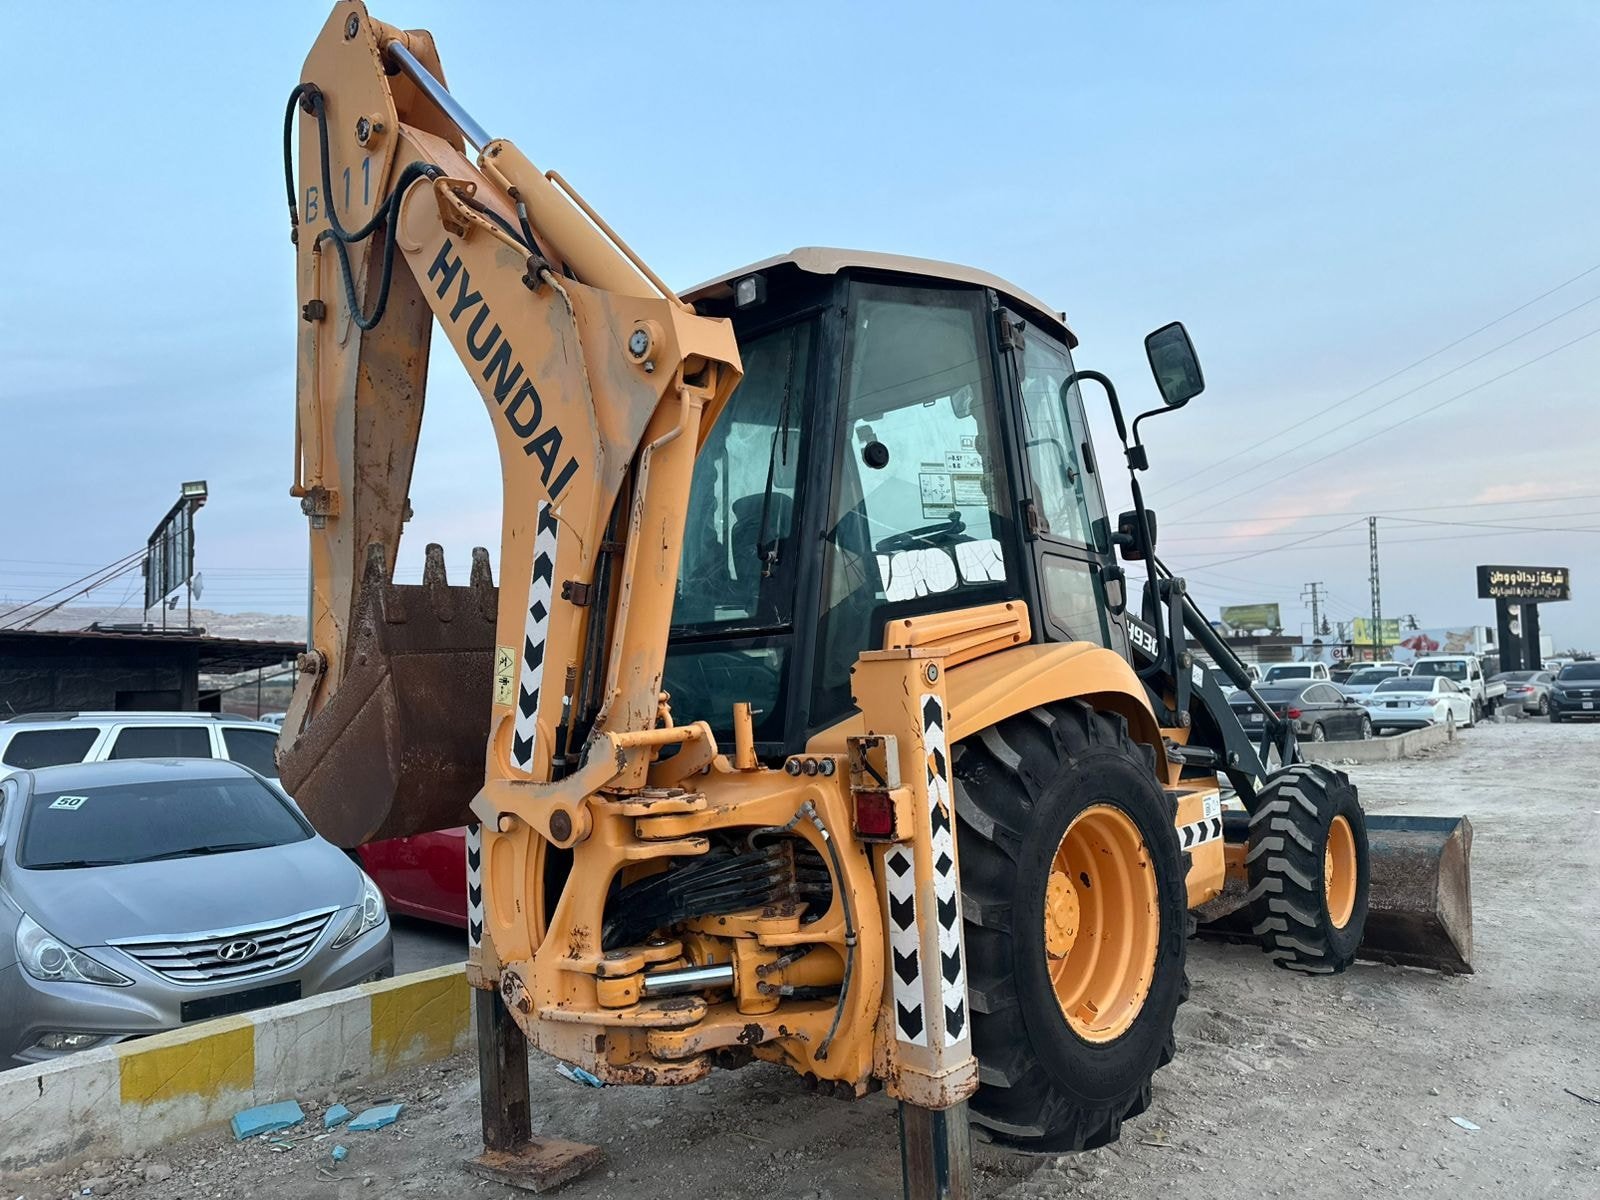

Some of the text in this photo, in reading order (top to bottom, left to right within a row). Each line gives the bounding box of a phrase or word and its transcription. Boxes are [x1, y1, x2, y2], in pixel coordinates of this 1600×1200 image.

[427, 237, 580, 502] HYUNDAI
[1517, 570, 1540, 586] زيدان
[1540, 570, 1564, 586] شركة
